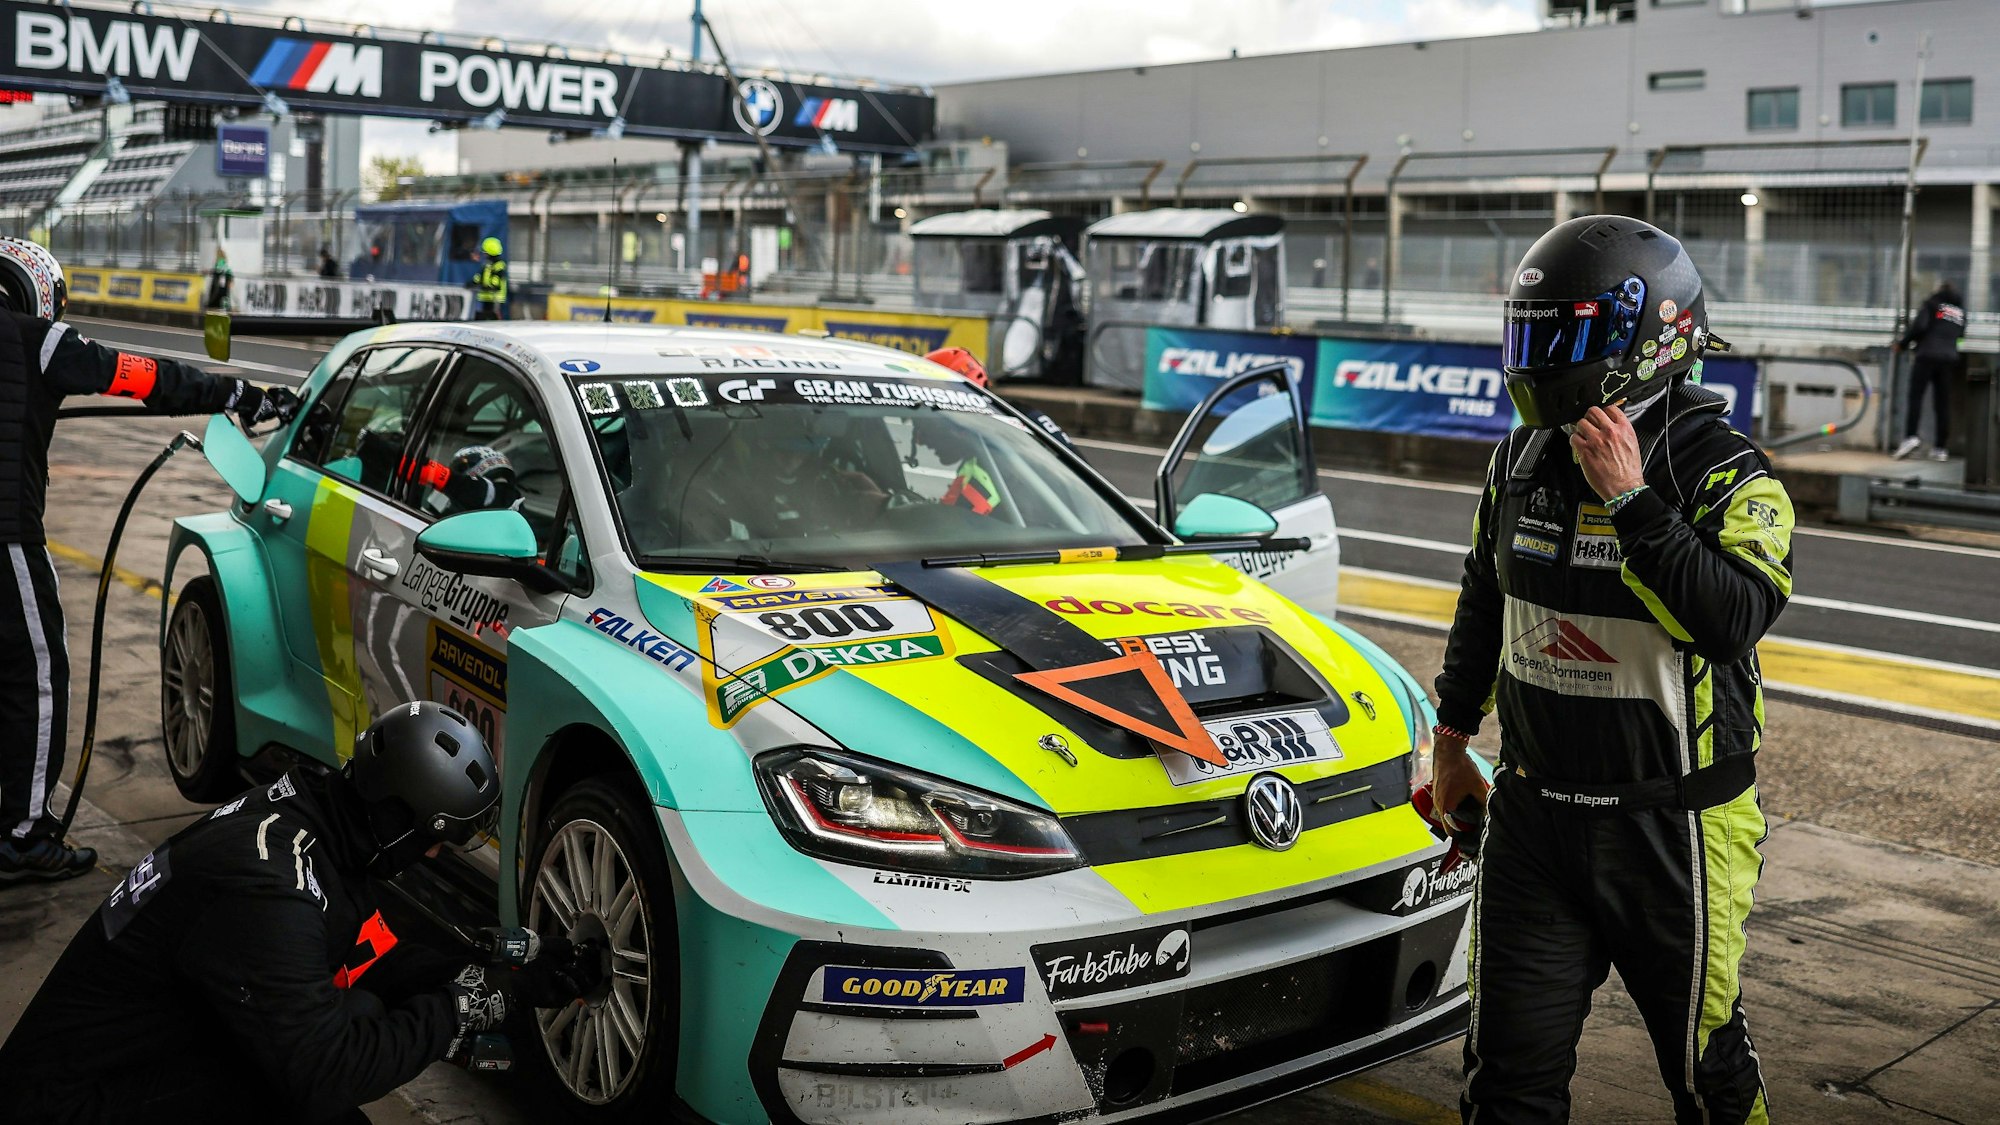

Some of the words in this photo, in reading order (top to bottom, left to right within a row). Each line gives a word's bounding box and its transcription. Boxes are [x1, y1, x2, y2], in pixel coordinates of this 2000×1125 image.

[15, 10, 199, 82] BMW
[419, 49, 618, 118] POWER
[699, 358, 841, 370] RACING
[1333, 359, 1502, 398] FALKEN
[793, 379, 872, 398] GRAN
[873, 382, 988, 409] TURISMO
[1448, 398, 1497, 418] TYRES
[1705, 468, 1738, 491] P1
[402, 553, 509, 635] LangeGruppe
[730, 586, 899, 607] RAVENOL
[1046, 595, 1272, 625] docare
[584, 607, 695, 673] FALKEN
[758, 604, 894, 641] 800
[438, 639, 503, 689] RAVENOL
[782, 639, 933, 680] DEKRA
[1541, 788, 1571, 803] Sven
[1046, 943, 1152, 992] Farbstube
